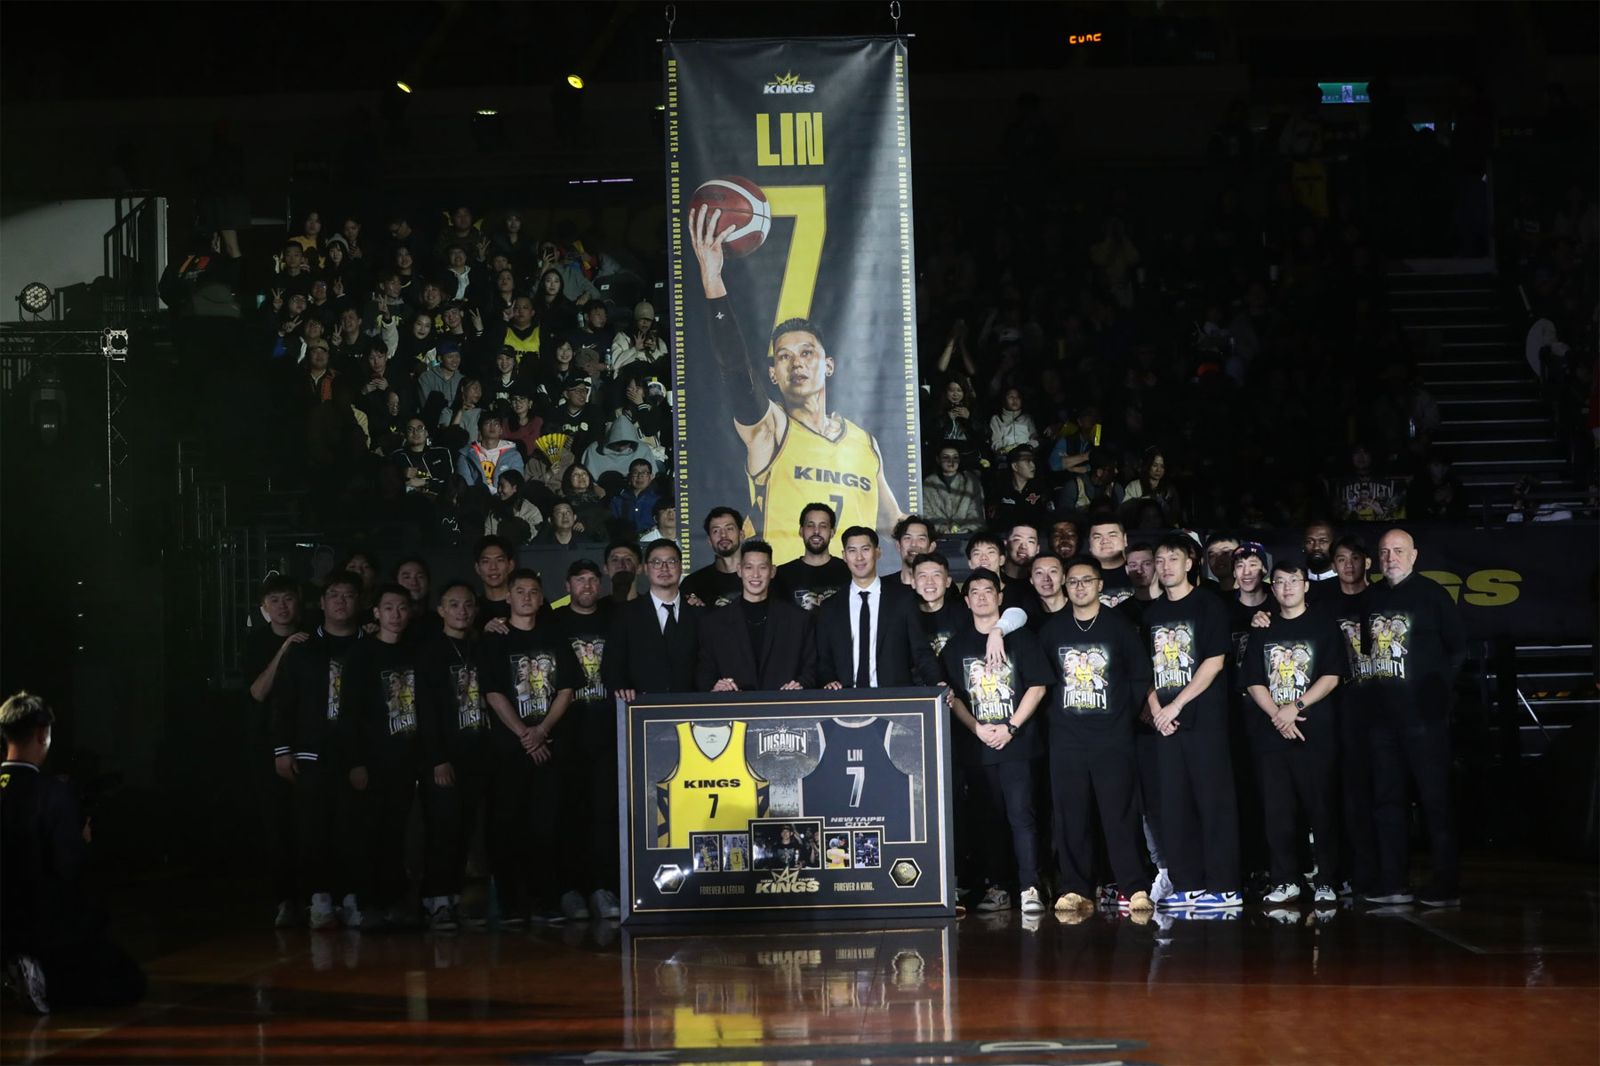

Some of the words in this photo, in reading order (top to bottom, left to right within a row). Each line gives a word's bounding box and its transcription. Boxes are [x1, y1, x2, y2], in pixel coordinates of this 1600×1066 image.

[668, 60, 677, 83] MORE
[895, 55, 904, 78] MORE
[669, 86, 677, 108] THAN
[763, 84, 815, 94] KINGS
[896, 81, 904, 103] THAN
[670, 120, 679, 152] PLAYER
[756, 112, 824, 166] LIN
[897, 115, 906, 147] PLAYER
[671, 177, 680, 205] HONOR
[672, 217, 682, 256] JOURNEY
[900, 212, 909, 250] JOURNEY
[674, 259, 682, 280] THAT
[760, 185, 827, 357] 7
[674, 283, 684, 327] RESHAPED
[675, 330, 685, 386] BASKETBALL
[903, 325, 913, 380] BASKETBALL
[677, 389, 687, 441] WORLDWIDE
[905, 383, 915, 435] WORLDWIDE
[679, 450, 687, 465] HIS
[794, 466, 871, 491] KINGS
[680, 492, 689, 525] LEGACY
[829, 495, 844, 533] 7
[909, 486, 918, 516] LEGAC
[1064, 687, 1107, 710] LINSANITY
[759, 731, 807, 755] LINSANITY
[847, 749, 863, 761] LIN
[684, 779, 741, 788] KINGS
[846, 766, 865, 808] 7
[708, 794, 719, 819] 7
[755, 880, 820, 893] KINGS
